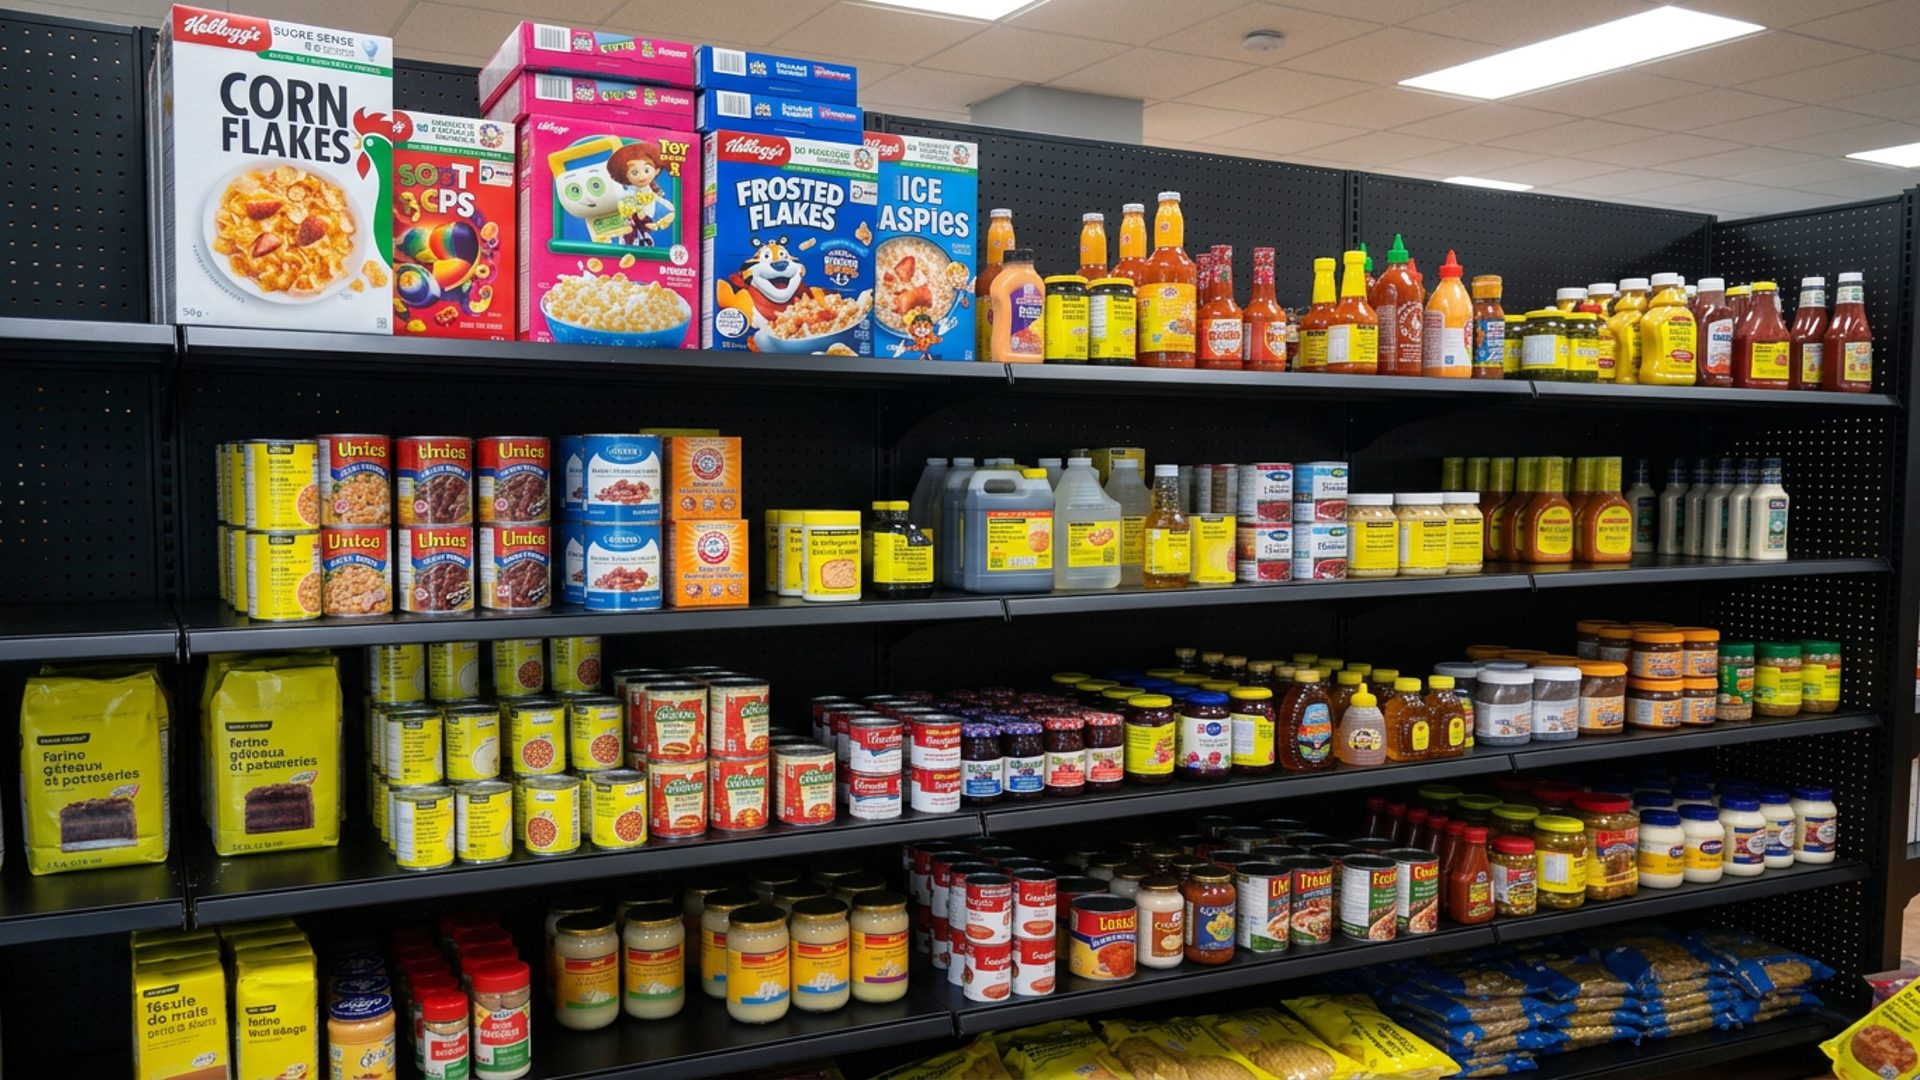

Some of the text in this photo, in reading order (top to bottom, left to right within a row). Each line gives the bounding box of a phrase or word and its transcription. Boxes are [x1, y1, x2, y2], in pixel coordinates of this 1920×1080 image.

[316, 33, 355, 48] SENSE
[220, 72, 348, 129] CORN
[222, 116, 351, 165] FLAKES
[736, 176, 845, 207] FROSTED
[902, 175, 942, 205] ICE
[749, 201, 837, 232] FLAKES
